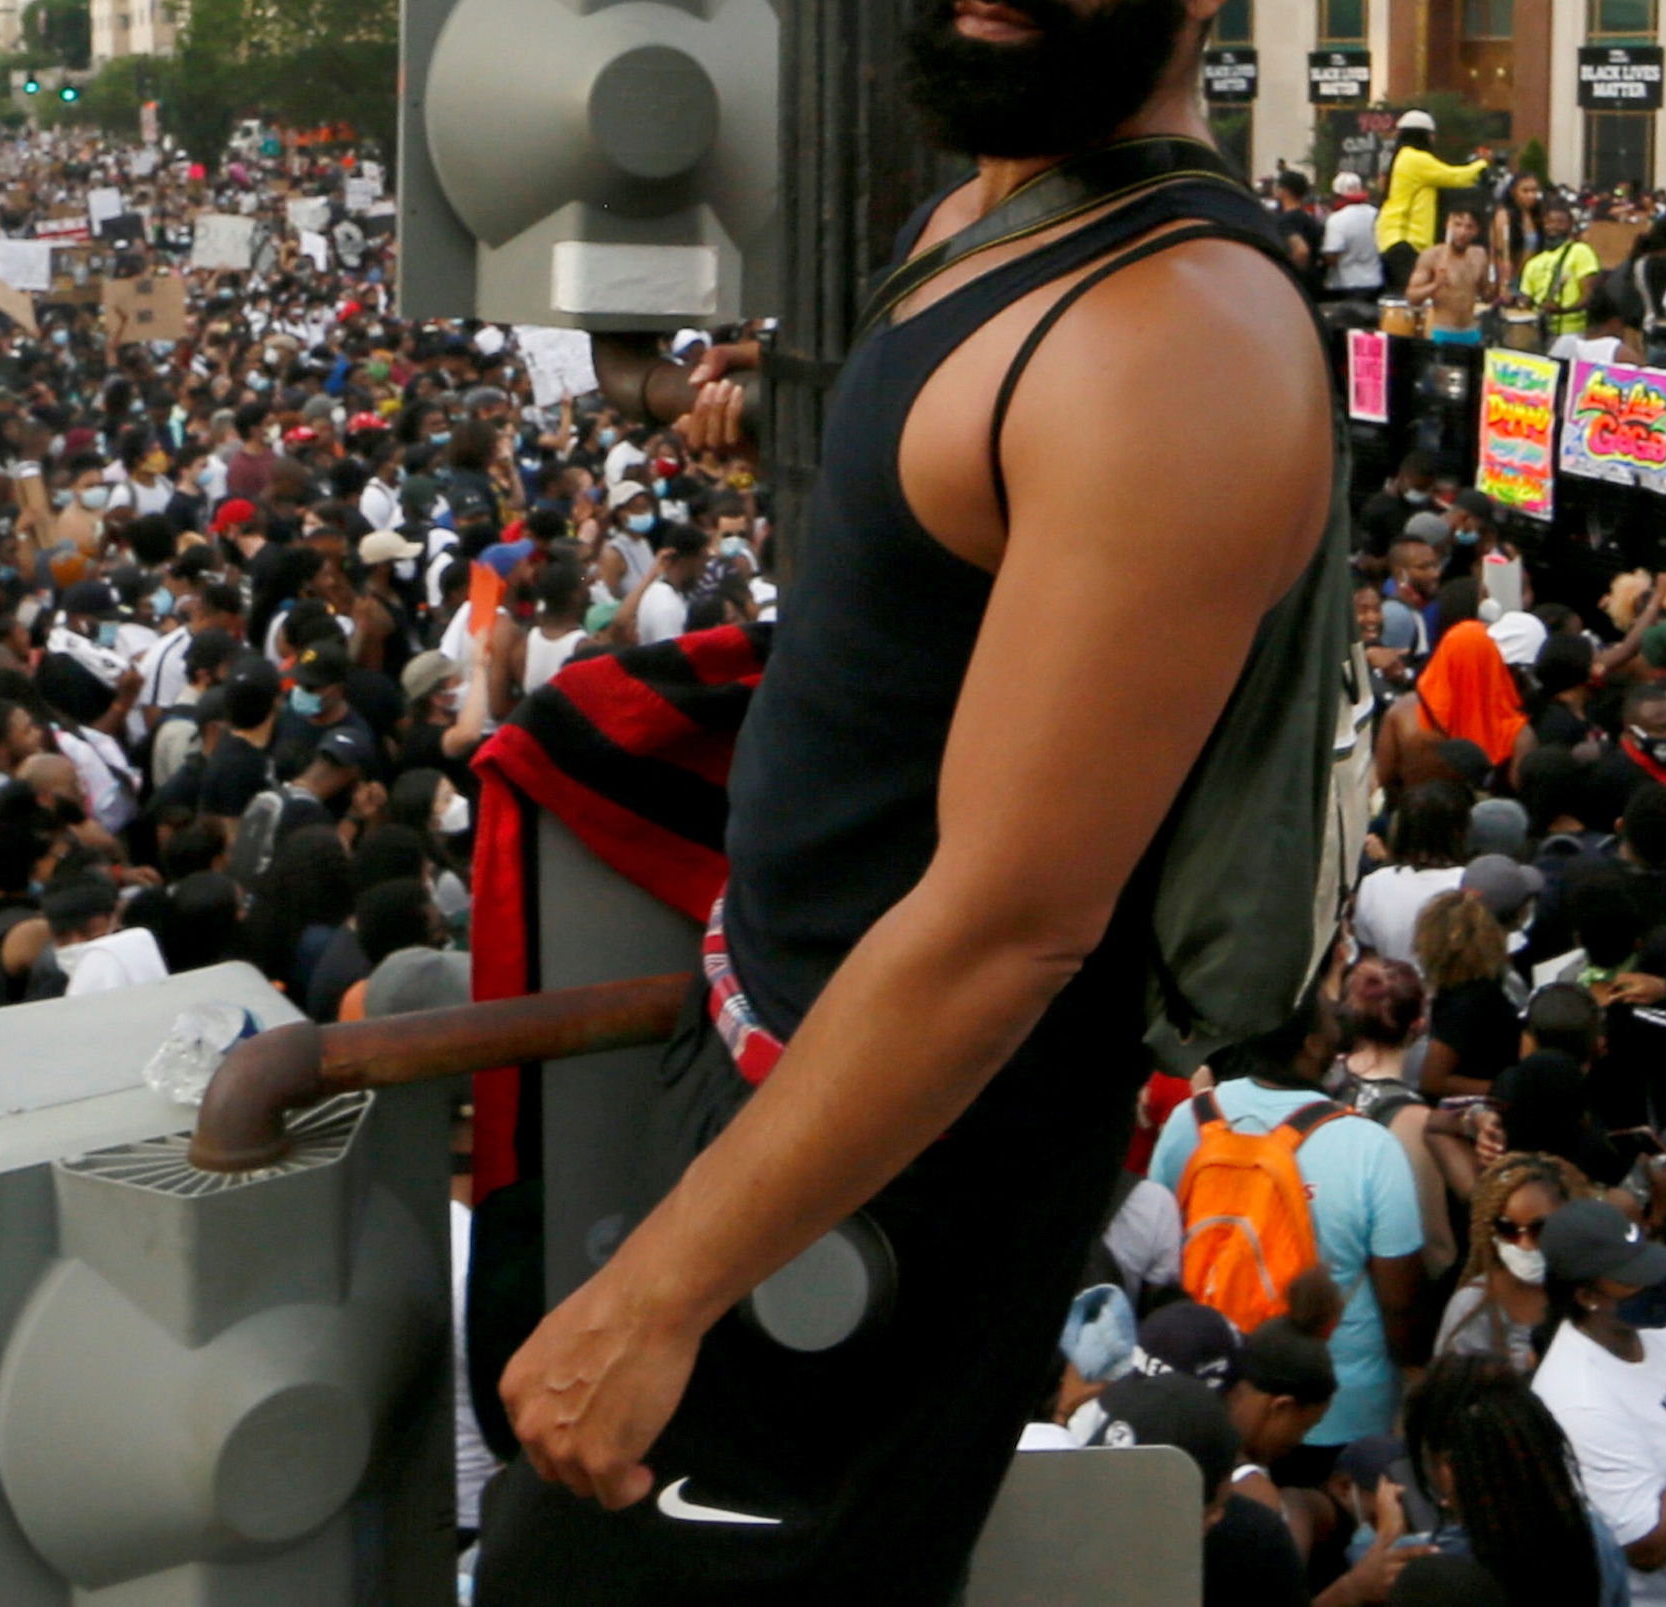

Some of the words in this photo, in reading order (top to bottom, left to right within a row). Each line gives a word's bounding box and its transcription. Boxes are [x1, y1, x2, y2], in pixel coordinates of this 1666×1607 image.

[1580, 65, 1621, 81] BLACK
[1622, 65, 1661, 81] LIVES
[1593, 82, 1647, 98] MATTER
